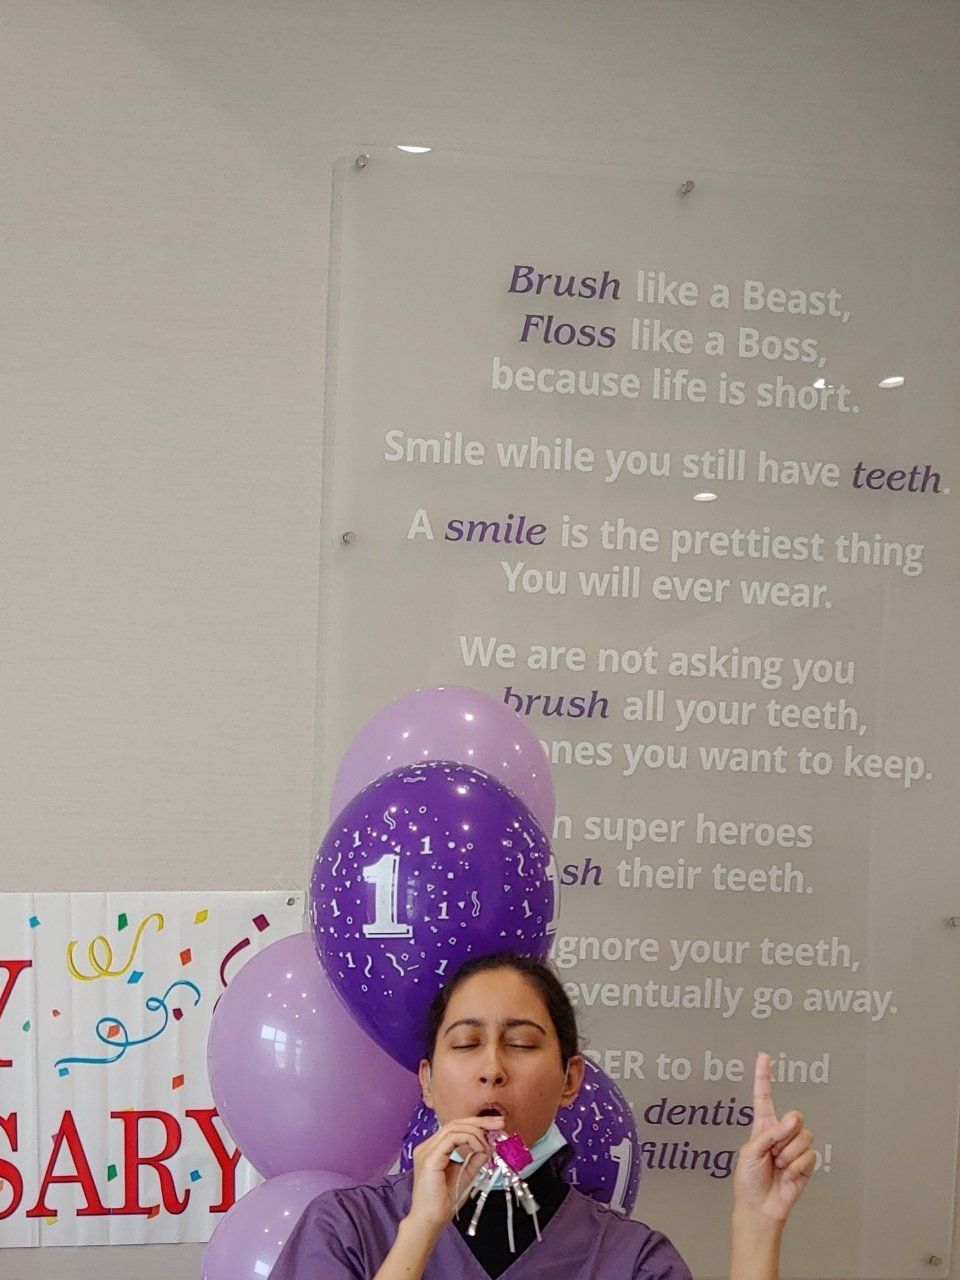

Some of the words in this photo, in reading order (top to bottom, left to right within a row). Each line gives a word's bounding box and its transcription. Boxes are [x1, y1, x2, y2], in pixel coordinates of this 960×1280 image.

[507, 264, 622, 300] Brush
[637, 270, 699, 307] like
[710, 282, 730, 309] a
[743, 279, 851, 323] Beast,
[519, 313, 617, 349] Floss
[631, 317, 694, 355] like
[705, 330, 725, 357] a
[738, 327, 827, 368] Boss,
[492, 357, 640, 399] because
[653, 367, 707, 403] life
[718, 371, 746, 406] is
[756, 376, 860, 415] short.
[384, 429, 486, 467] Smile
[497, 435, 595, 473] while
[606, 448, 671, 484] you
[682, 446, 746, 482] still
[758, 451, 840, 488] have
[851, 461, 951, 496] teeth.
[407, 508, 434, 541] A
[444, 513, 547, 546] smile
[561, 515, 588, 550] is
[600, 517, 659, 553] the
[671, 524, 824, 563] prettiest
[835, 532, 925, 577] thing
[501, 560, 567, 596] You
[579, 565, 640, 600] will
[652, 572, 730, 603] ever
[741, 578, 833, 610] wear.
[459, 634, 515, 669] We
[527, 643, 586, 672] are
[598, 643, 658, 676] not
[668, 646, 784, 689] asking
[792, 658, 855, 693] you
[503, 686, 610, 720] brush
[623, 690, 665, 723] all
[676, 696, 756, 731] your
[766, 699, 868, 736] teeth,
[622, 740, 688, 776] you
[699, 742, 788, 775] want
[798, 745, 834, 775] to
[843, 746, 933, 788] keep.
[583, 816, 685, 850] super
[695, 813, 814, 849] heroes
[362, 854, 413, 938] 1
[617, 858, 702, 892] their
[712, 861, 814, 895] teeth.
[549, 935, 659, 969] gnore
[670, 938, 749, 972] your
[760, 936, 861, 972] teeth,
[563, 978, 743, 1019] eventually
[751, 987, 793, 1019] go
[803, 988, 899, 1021] away.
[656, 1052, 691, 1082] to
[703, 1050, 744, 1082] be
[644, 1097, 754, 1126] dentis
